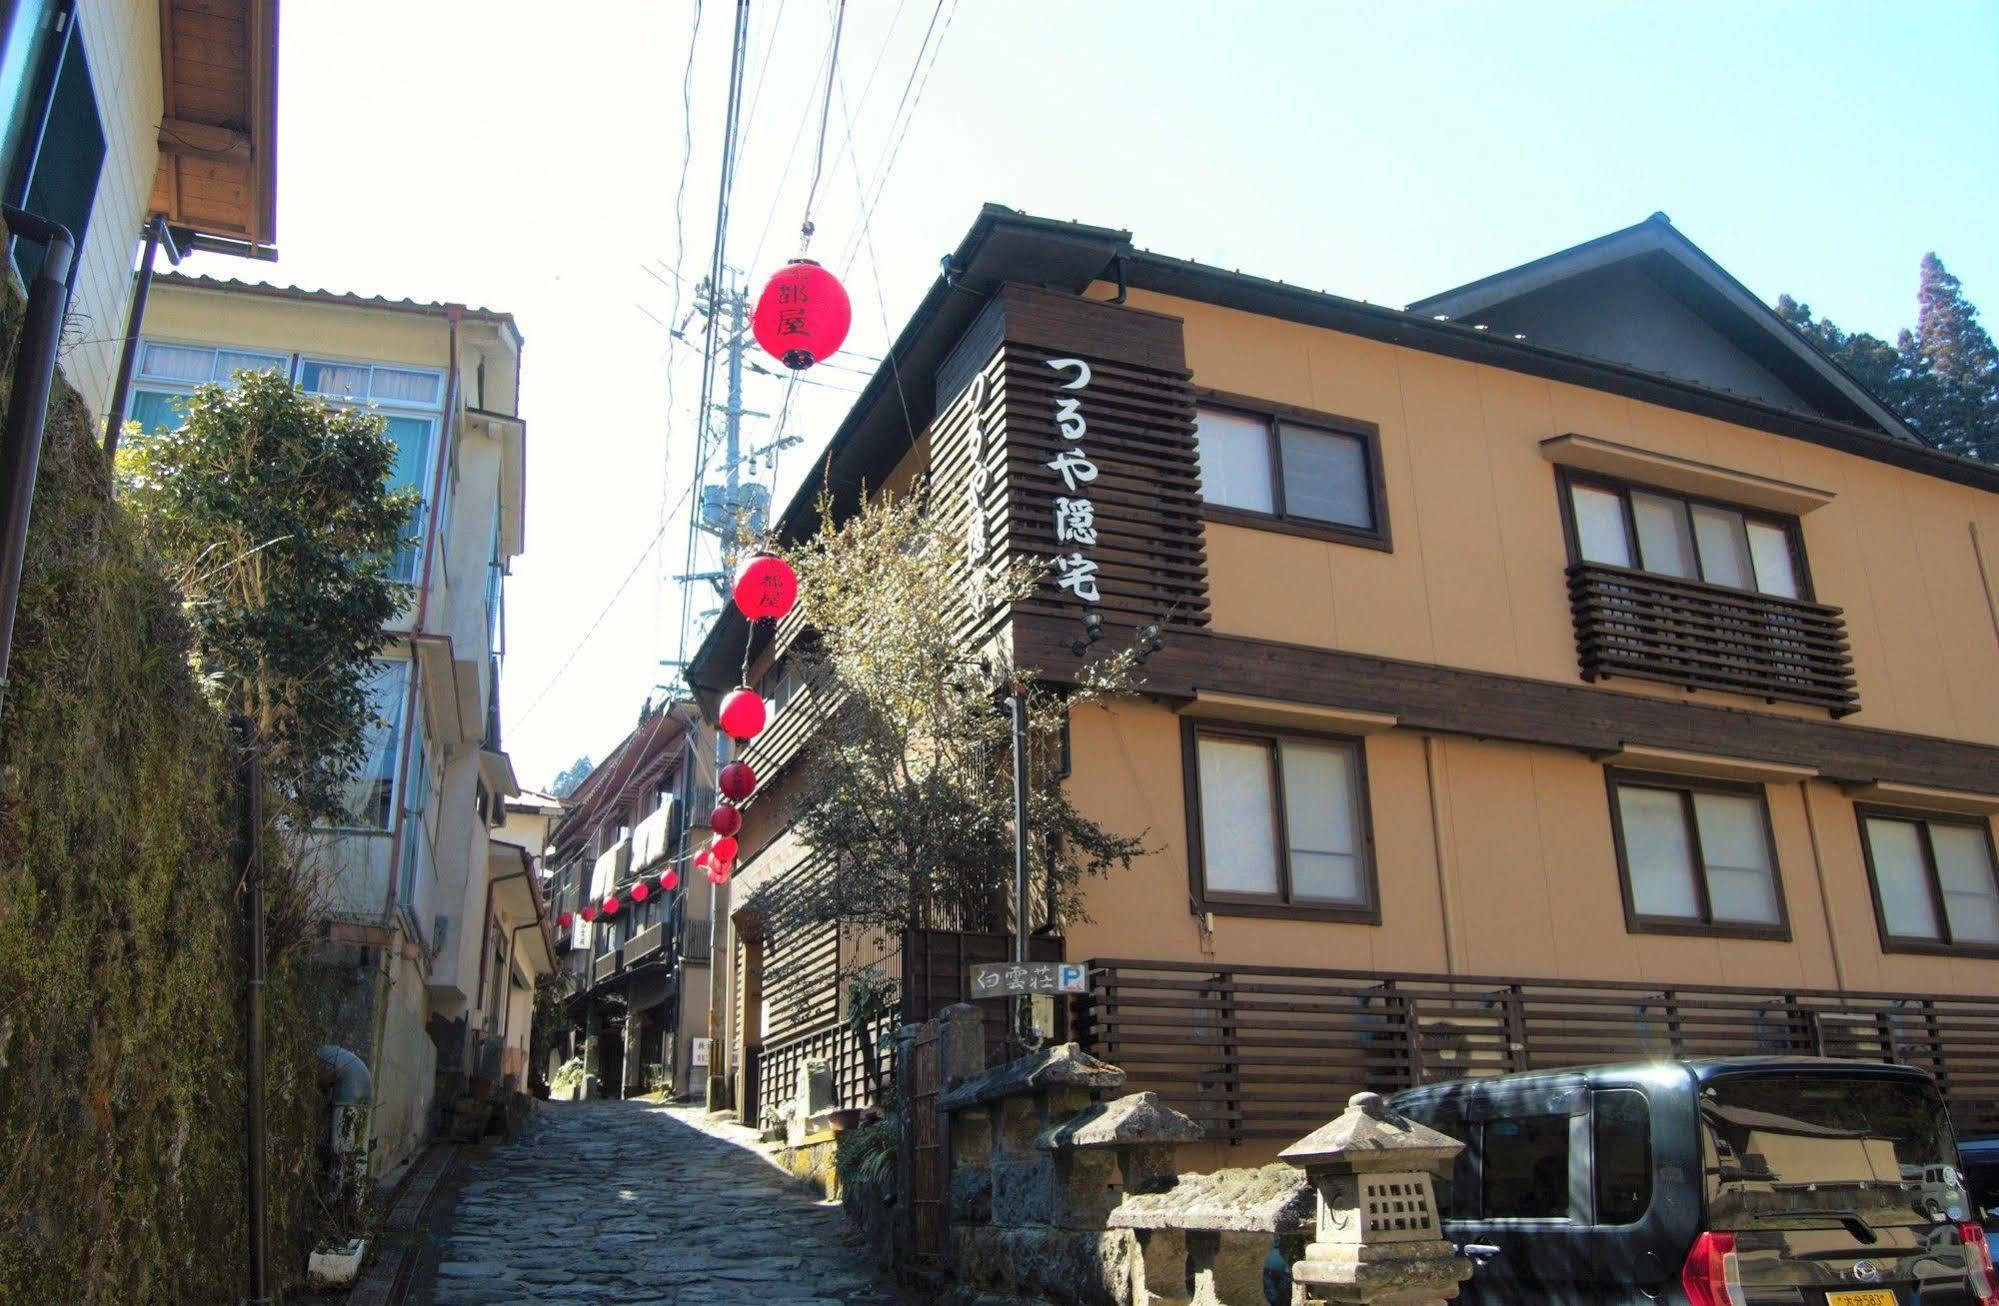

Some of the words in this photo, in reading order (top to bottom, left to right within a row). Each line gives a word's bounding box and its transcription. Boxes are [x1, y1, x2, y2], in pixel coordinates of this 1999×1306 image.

[1046, 358, 1100, 601] つるや隠宅
[977, 965, 1054, 990] 白雲荘
[1063, 967, 1081, 986] P
